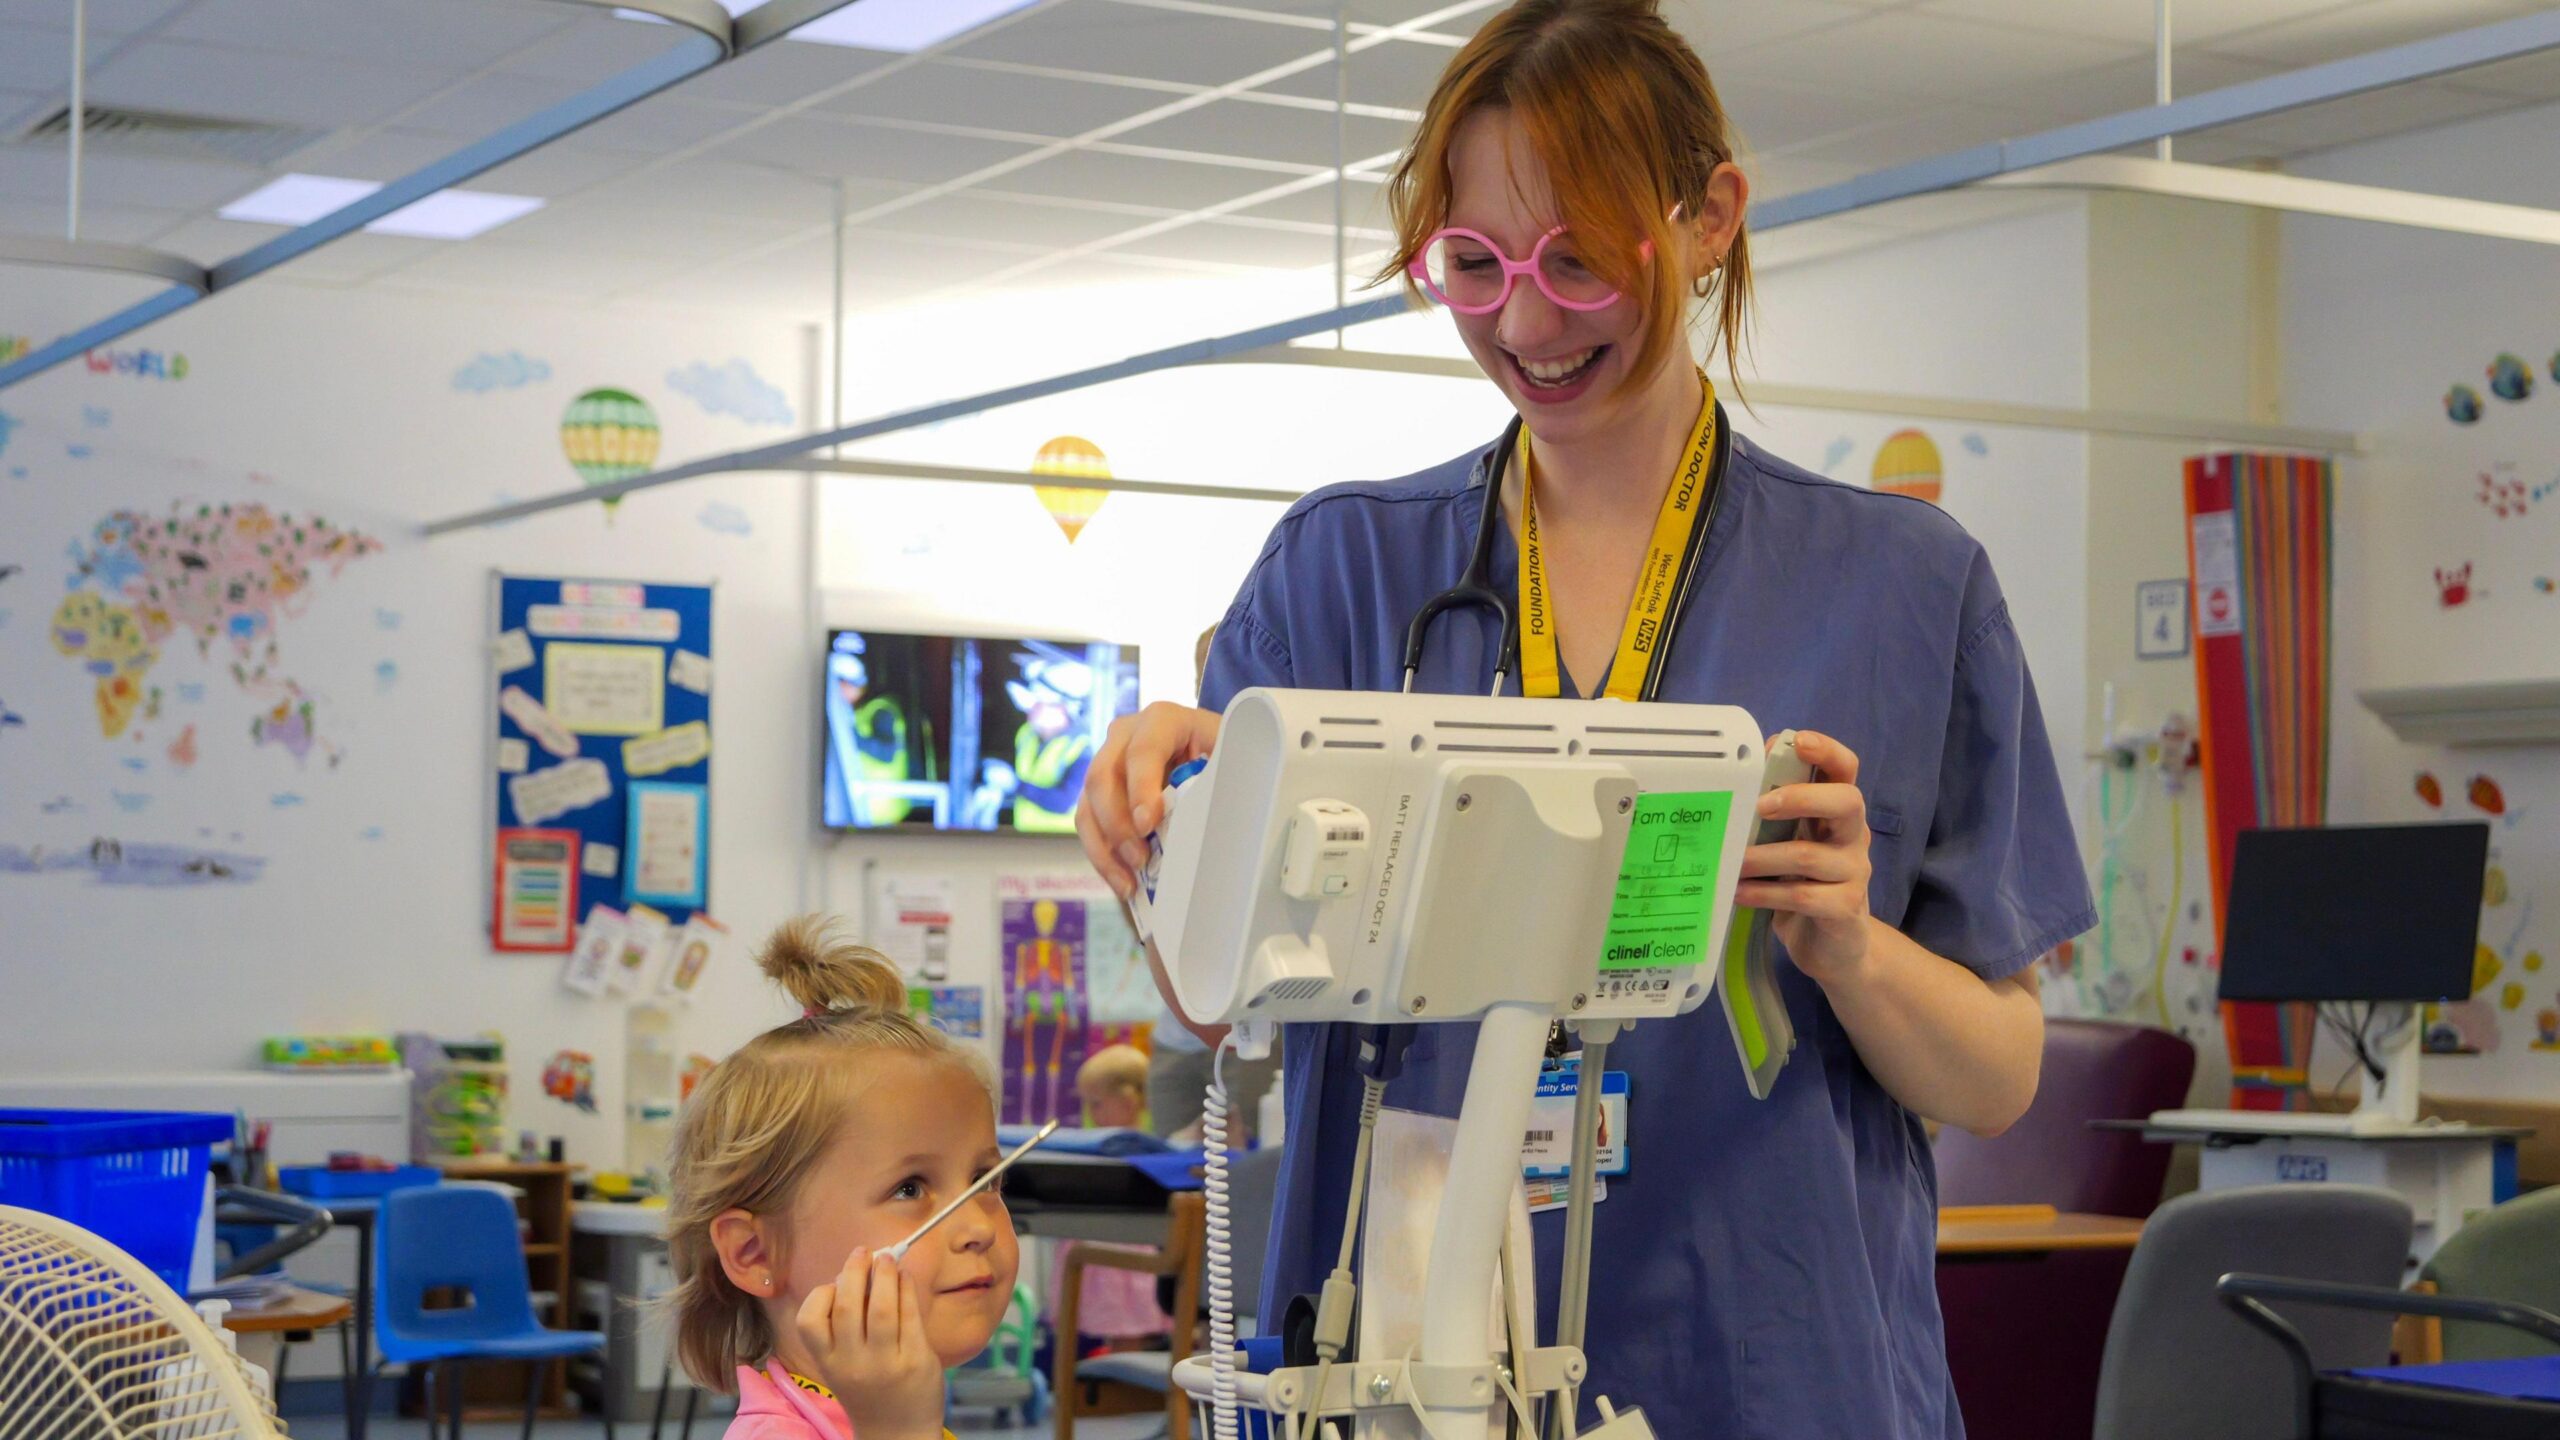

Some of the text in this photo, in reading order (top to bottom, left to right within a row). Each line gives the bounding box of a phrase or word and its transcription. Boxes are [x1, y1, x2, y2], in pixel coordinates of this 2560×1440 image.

[1674, 450, 1703, 512] DOCTOR
[1529, 544, 1545, 636] FOUNDATION
[1647, 553, 1674, 614] West Suffolk
[1634, 618, 1657, 653] NHS
[2154, 613, 2170, 642] 4
[1632, 808, 1712, 826] I am clean
[1368, 794, 1411, 944] BATT REPLACED OCT 24
[1607, 942, 1695, 961] clinell clean
[1536, 1083, 1578, 1094] ntity Serv
